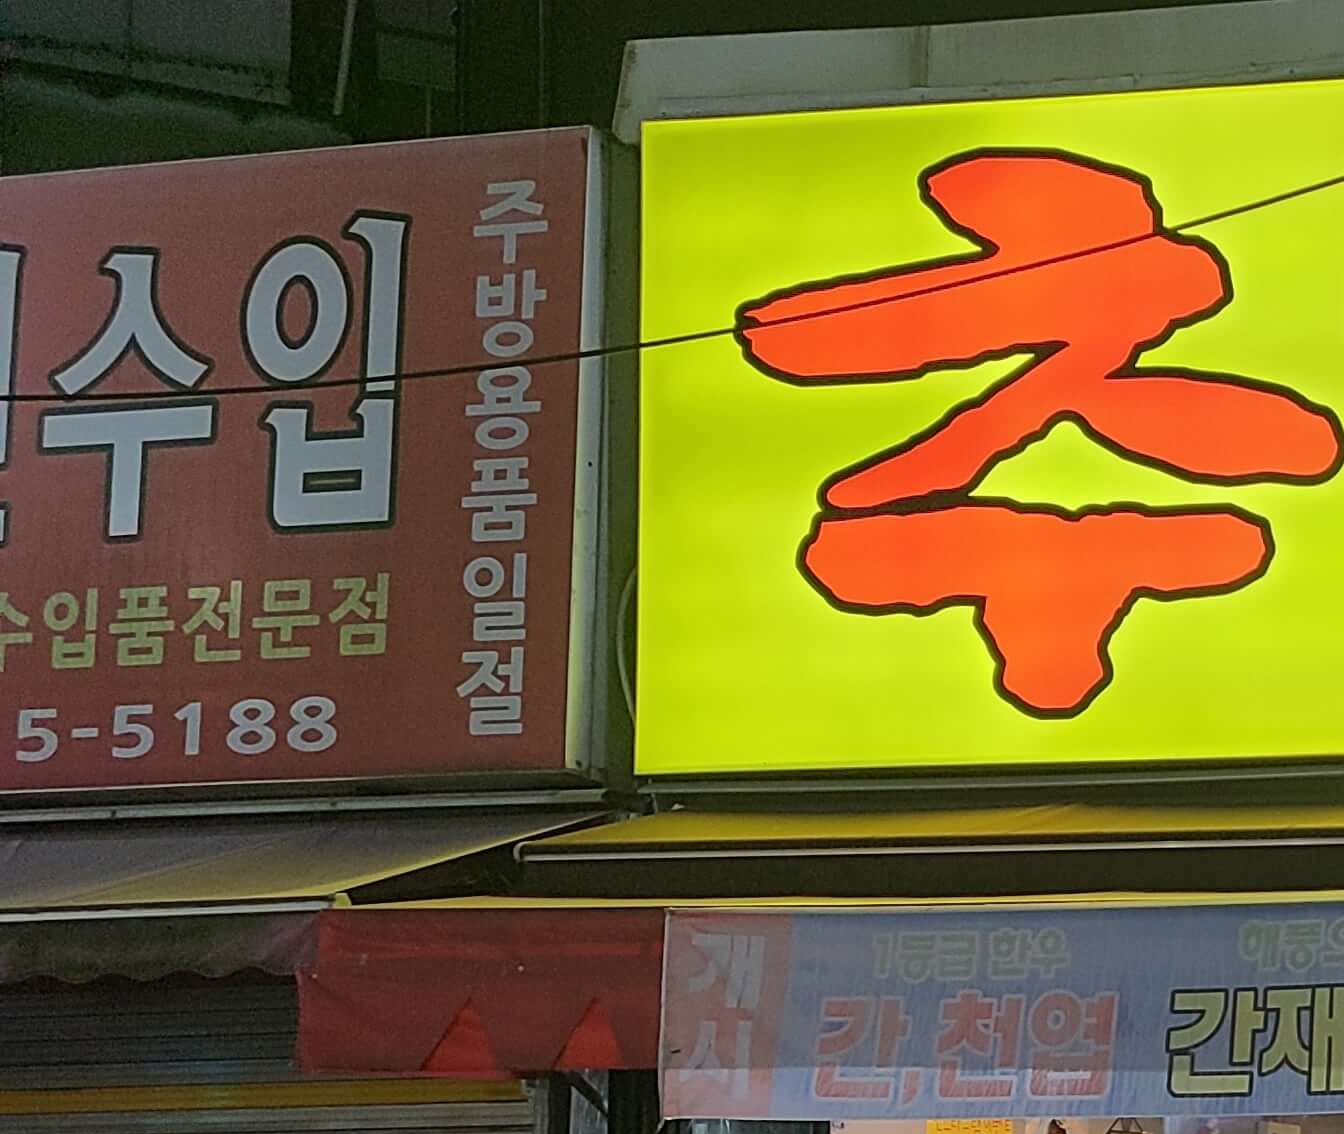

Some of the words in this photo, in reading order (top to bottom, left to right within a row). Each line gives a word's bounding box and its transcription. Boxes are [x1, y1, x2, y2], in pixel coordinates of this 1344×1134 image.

[15, 696, 338, 763] 5-5188
[873, 929, 979, 982] 1등급
[988, 926, 1071, 979] 한우
